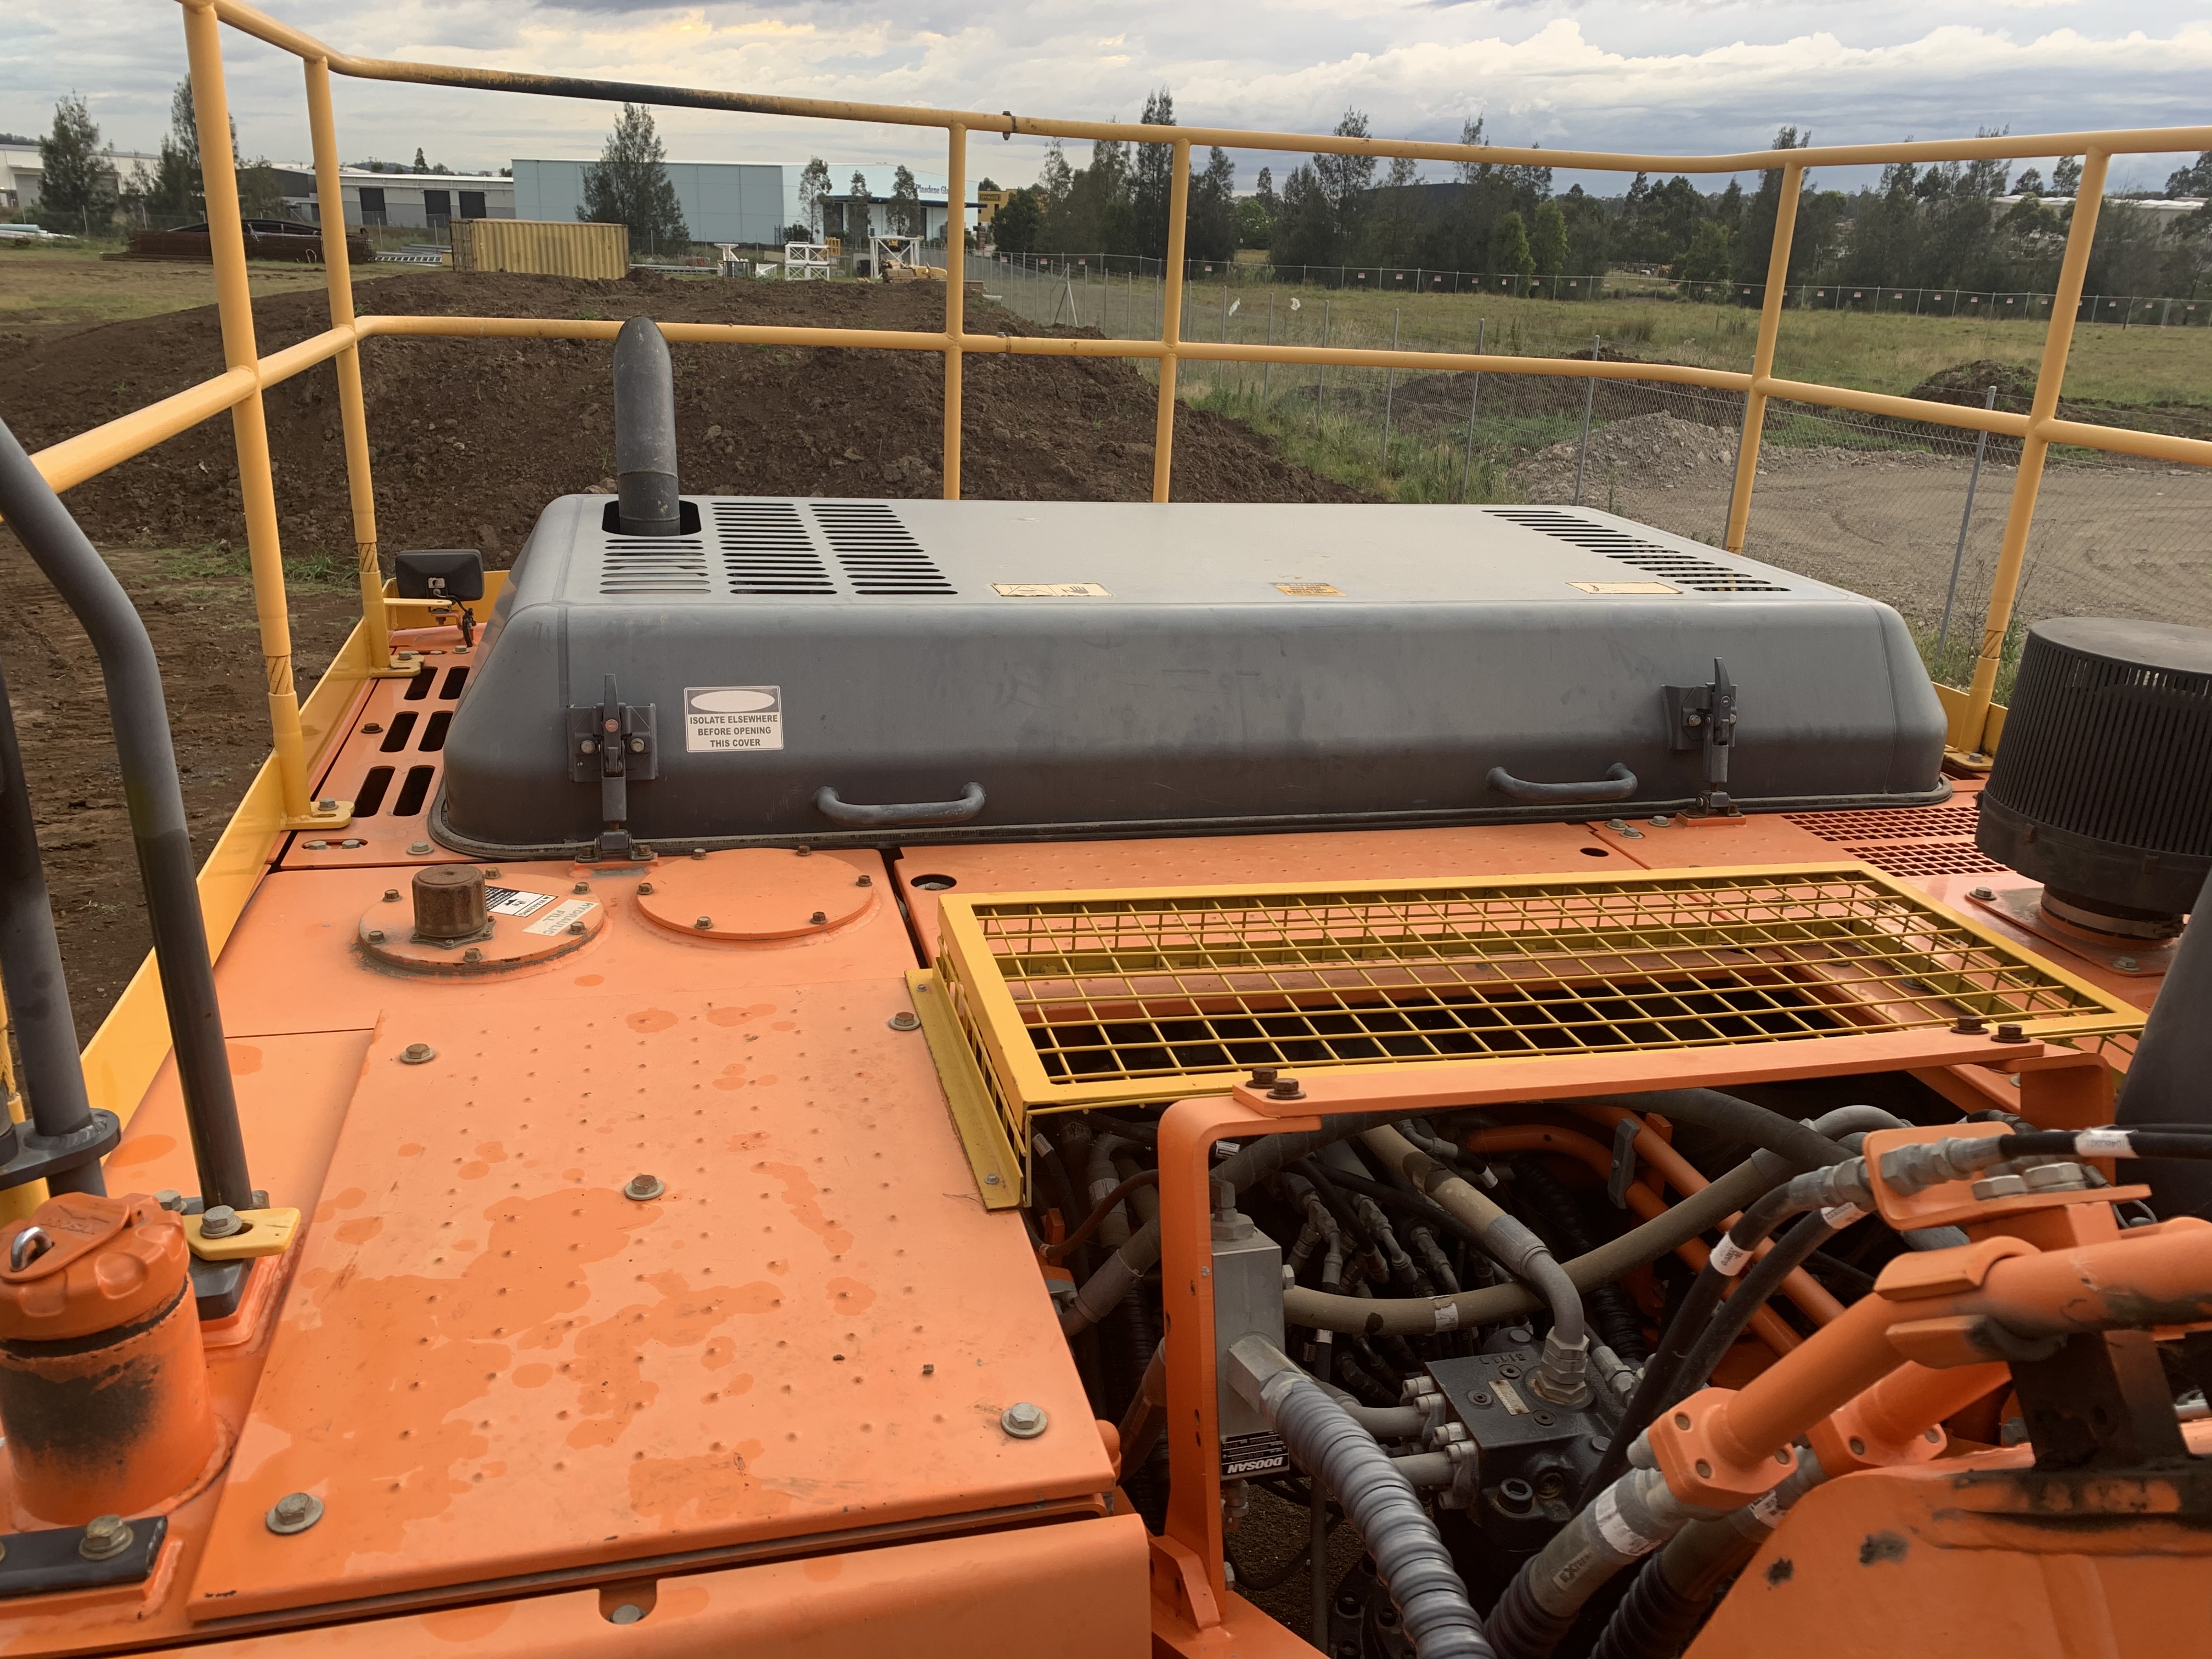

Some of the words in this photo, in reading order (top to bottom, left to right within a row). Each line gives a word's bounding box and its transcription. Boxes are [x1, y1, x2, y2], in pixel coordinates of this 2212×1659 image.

[690, 715, 725, 724] ISOLATE
[727, 714, 778, 723] ELSEWHERE
[698, 727, 731, 736] BEFORE
[733, 726, 771, 735] OPENING
[732, 738, 761, 747] COVER
[518, 898, 546, 916] WARNING
[542, 910, 566, 922] FILL
[543, 902, 594, 935] HYDRAULIC
[1227, 1457, 1283, 1474] DOOSAN
